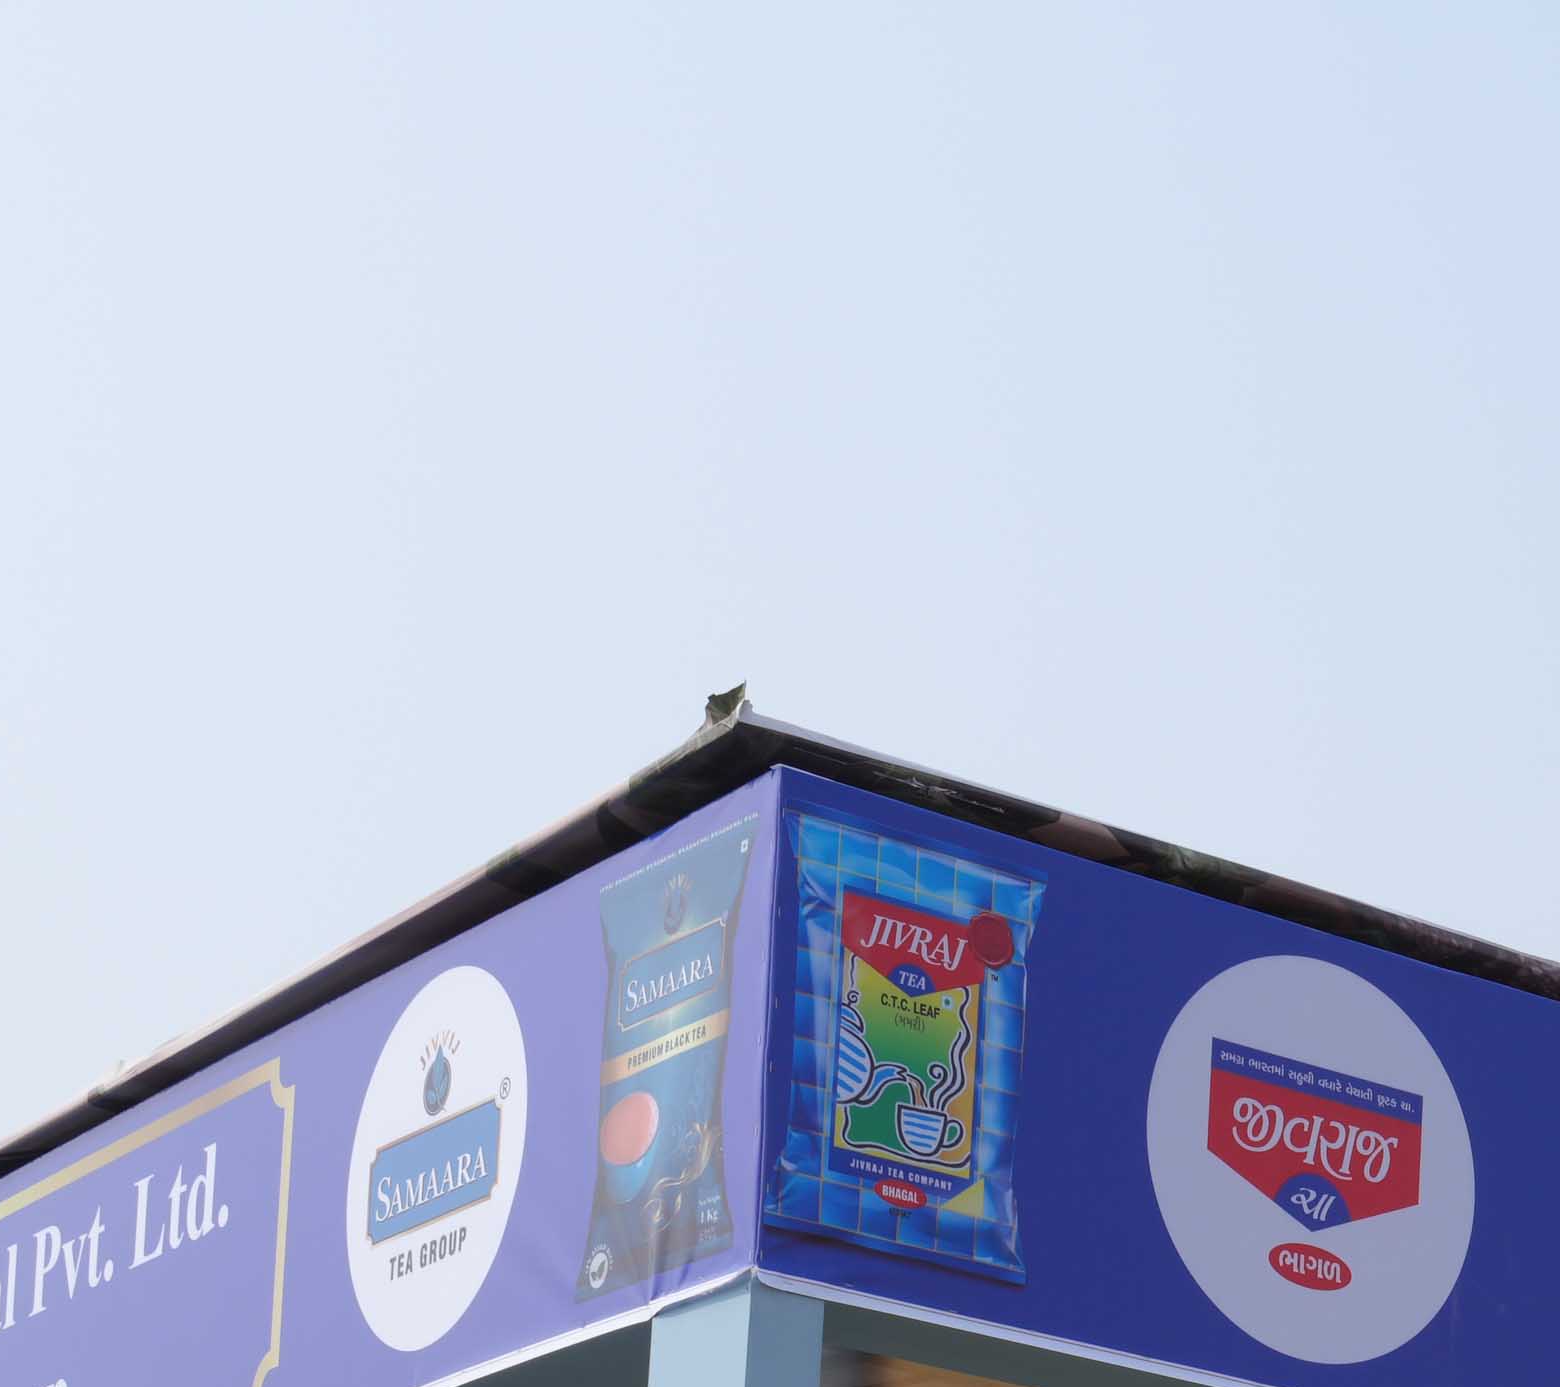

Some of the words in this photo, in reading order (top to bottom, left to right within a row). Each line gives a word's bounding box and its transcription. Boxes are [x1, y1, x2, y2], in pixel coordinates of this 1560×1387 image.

[860, 914, 968, 971] JIVRAJ
[899, 970, 926, 991] TEA
[880, 993, 911, 1012] C.T.C.
[913, 1001, 940, 1019] LEAF
[627, 1042, 664, 1069] PREMIUM
[665, 1032, 690, 1053] BLACK
[692, 1024, 707, 1042] TEA
[1231, 1096, 1399, 1184] જીવરાજ
[850, 1158, 883, 1175] JIVRAJ
[888, 1167, 904, 1180] TEA
[908, 1172, 952, 1191] COMPANY
[882, 1184, 919, 1204] BHAGAL
[1291, 1187, 1336, 1221] ચા
[29, 1205, 115, 1317] Pvt.
[129, 1142, 229, 1270] Ltd.
[389, 1255, 413, 1281] TEA
[420, 1227, 467, 1268] GROUP
